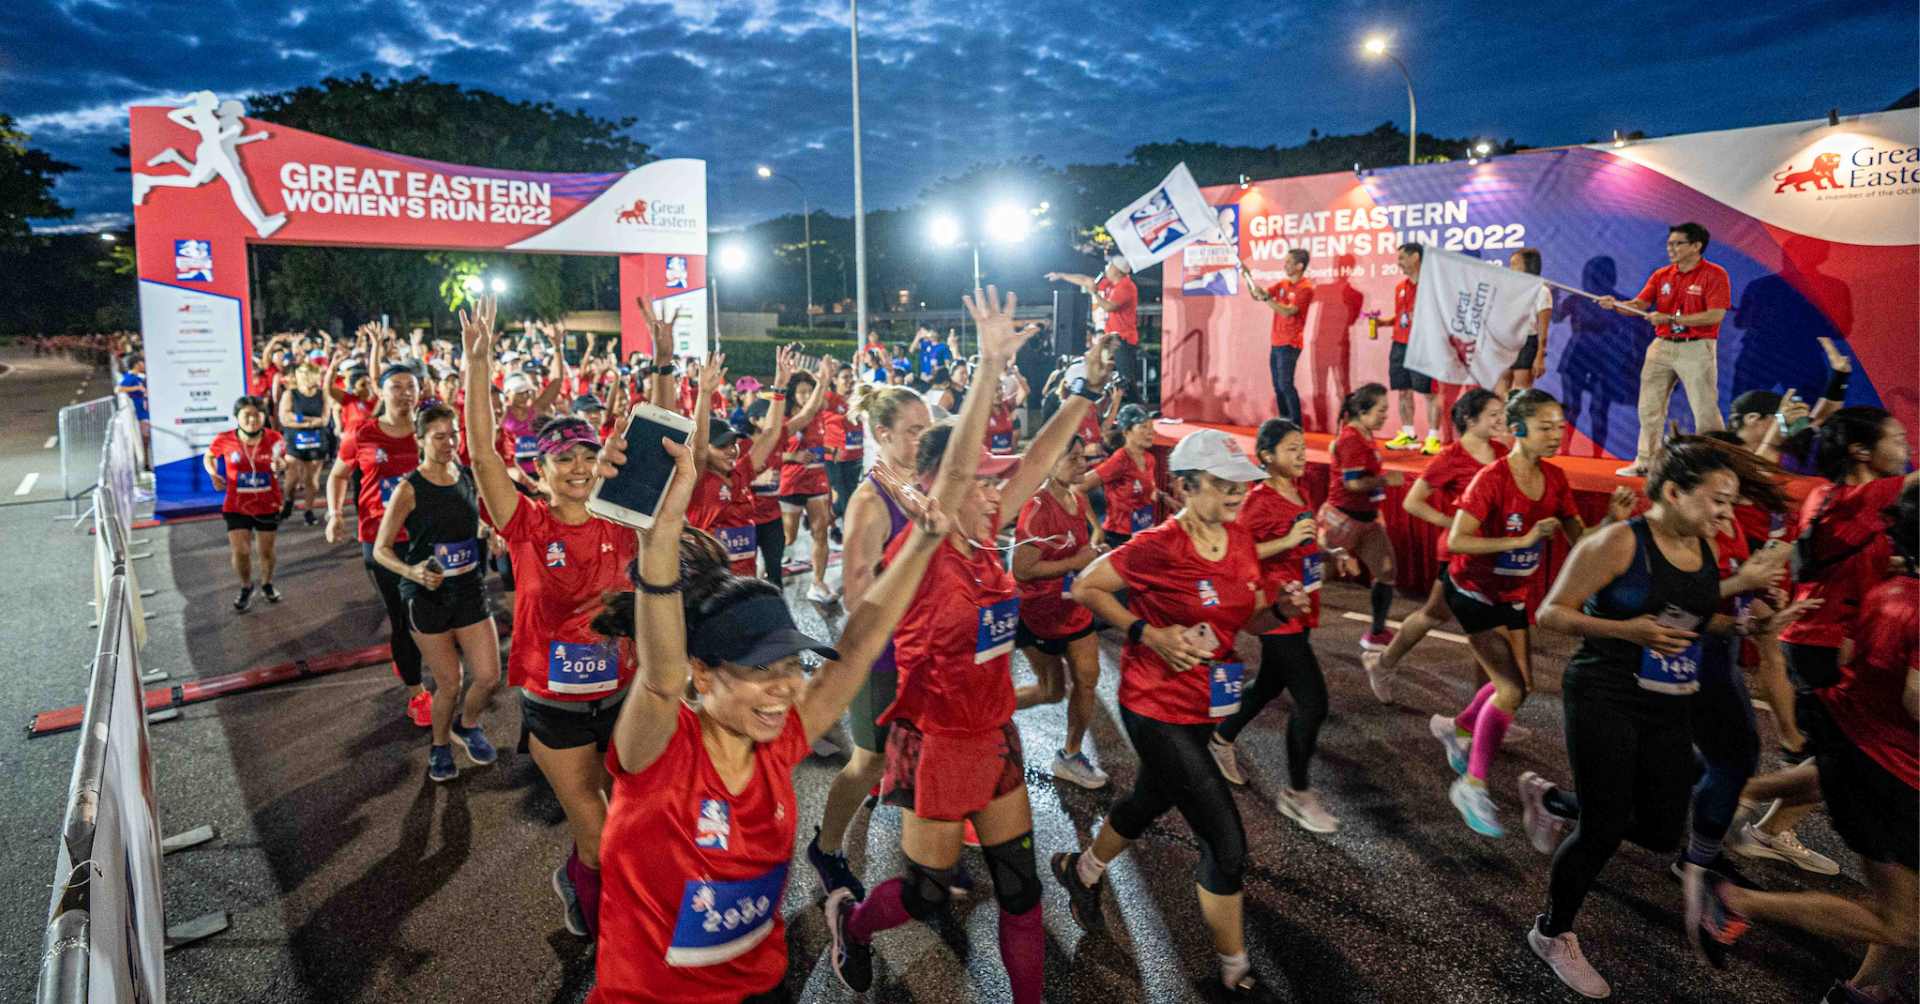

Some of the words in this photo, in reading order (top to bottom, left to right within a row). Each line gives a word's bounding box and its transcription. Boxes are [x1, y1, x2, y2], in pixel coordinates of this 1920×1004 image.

[280, 162, 400, 196] GREAT
[406, 171, 551, 206] EASTERN
[1825, 191, 1863, 200] member
[1865, 190, 1876, 198] of
[281, 188, 425, 219] WOMEN'S
[430, 201, 485, 222] RUN
[490, 203, 551, 225] 2022
[651, 200, 685, 215] Great
[651, 214, 696, 228] Eastern
[1249, 210, 1331, 238] GREAT
[1335, 199, 1468, 231] EASTERN
[1249, 232, 1373, 261] WOMEN'S
[1377, 229, 1439, 255] RUN
[1444, 223, 1525, 251] 2022
[1250, 268, 1288, 281] Singap
[1341, 264, 1365, 277] Hub
[1451, 291, 1471, 333] Great
[1464, 282, 1489, 337] Eastern
[562, 660, 607, 673] 2008
